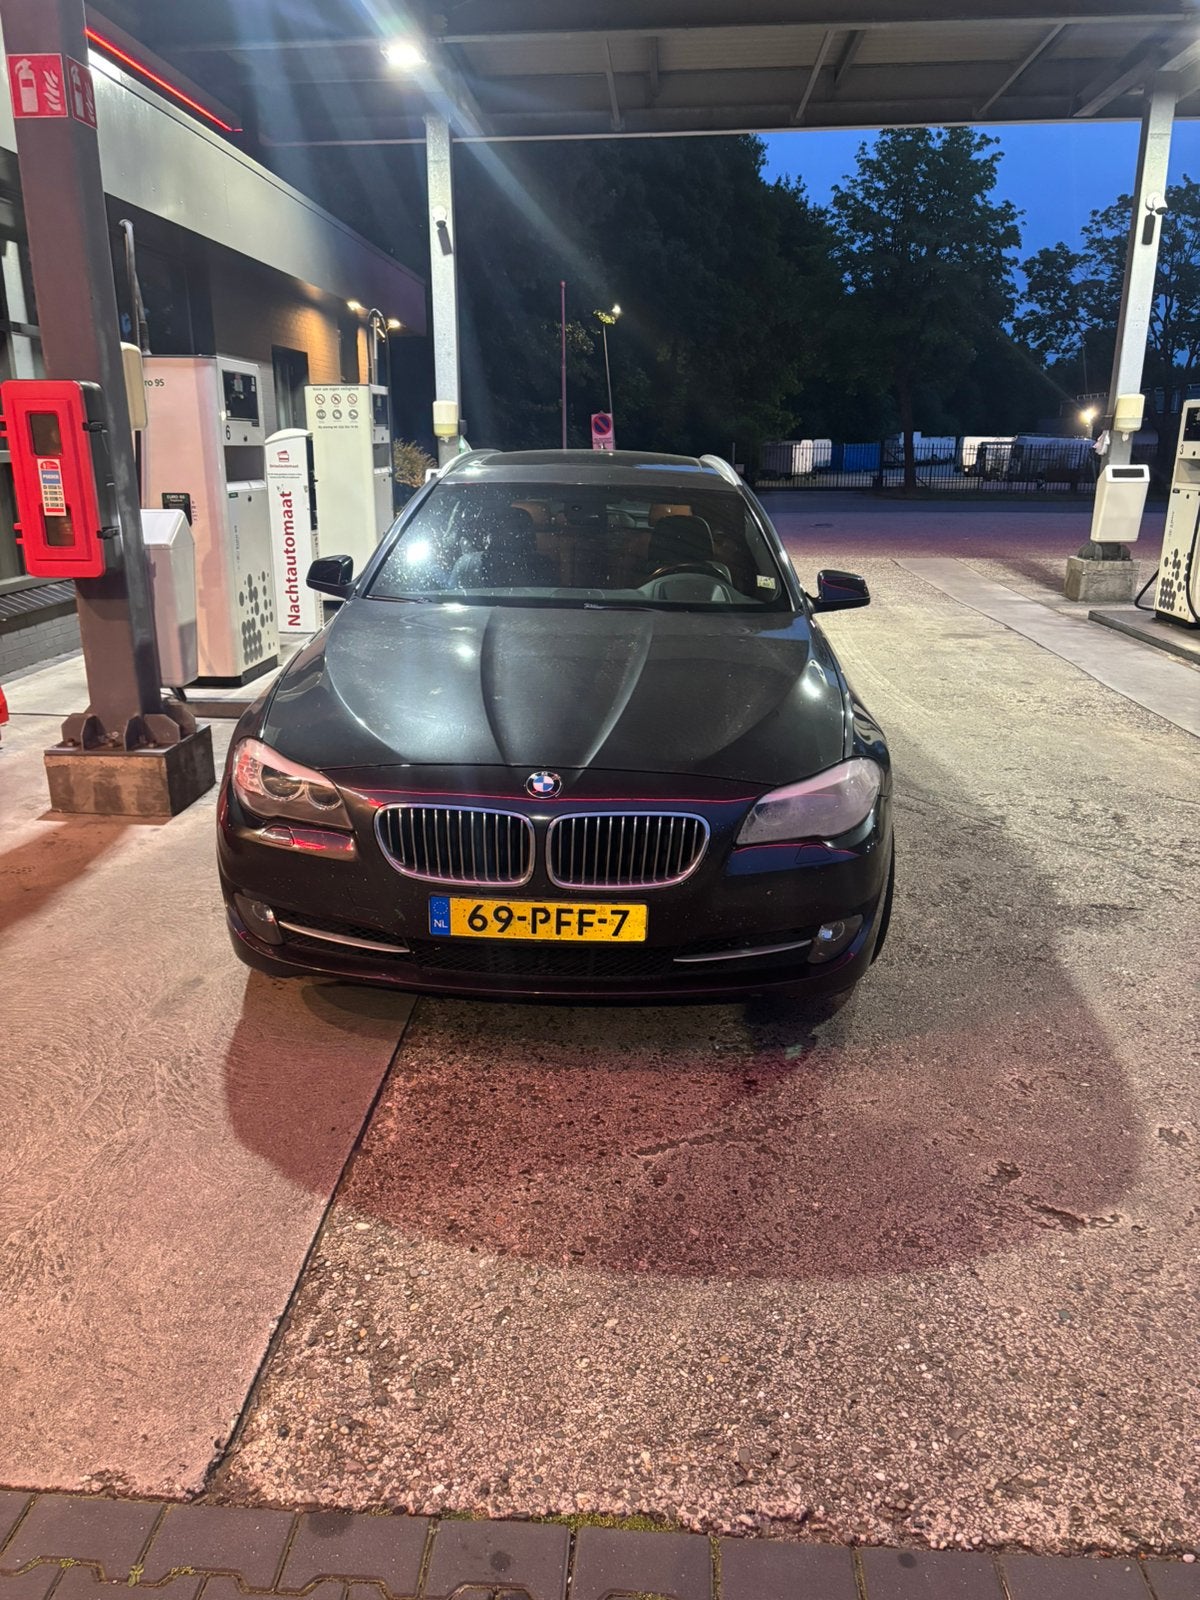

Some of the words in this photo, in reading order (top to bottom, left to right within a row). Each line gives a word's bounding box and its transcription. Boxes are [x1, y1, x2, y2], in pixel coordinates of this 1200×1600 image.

[155, 378, 165, 387] 95
[225, 425, 231, 440] 6
[1179, 444, 1185, 455] 3
[280, 490, 301, 626] Nachtautomaat
[433, 919, 448, 928] NL
[467, 904, 630, 937] 69-PFF-7
